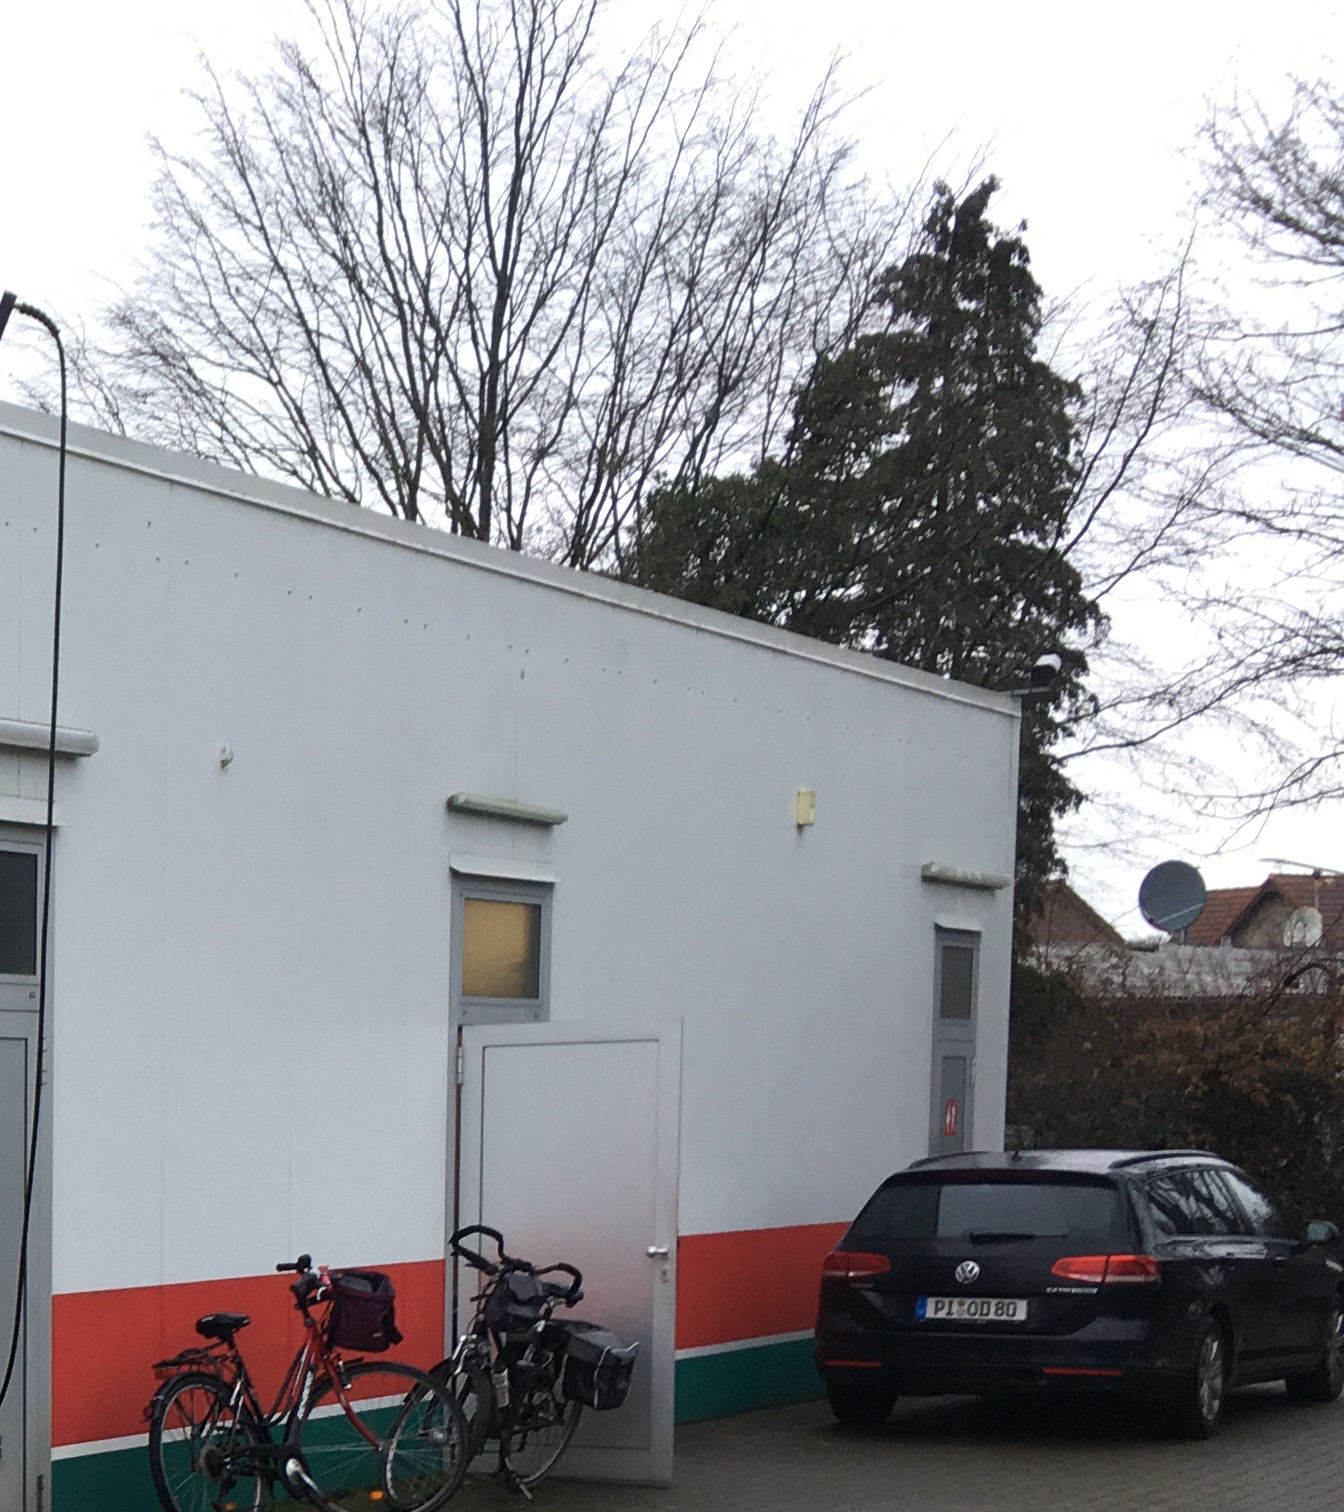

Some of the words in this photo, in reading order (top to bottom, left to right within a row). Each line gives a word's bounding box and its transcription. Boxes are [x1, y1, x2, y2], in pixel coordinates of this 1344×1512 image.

[933, 1300, 954, 1316] PI
[966, 1300, 991, 1317] OD
[994, 1300, 1017, 1318] 80
